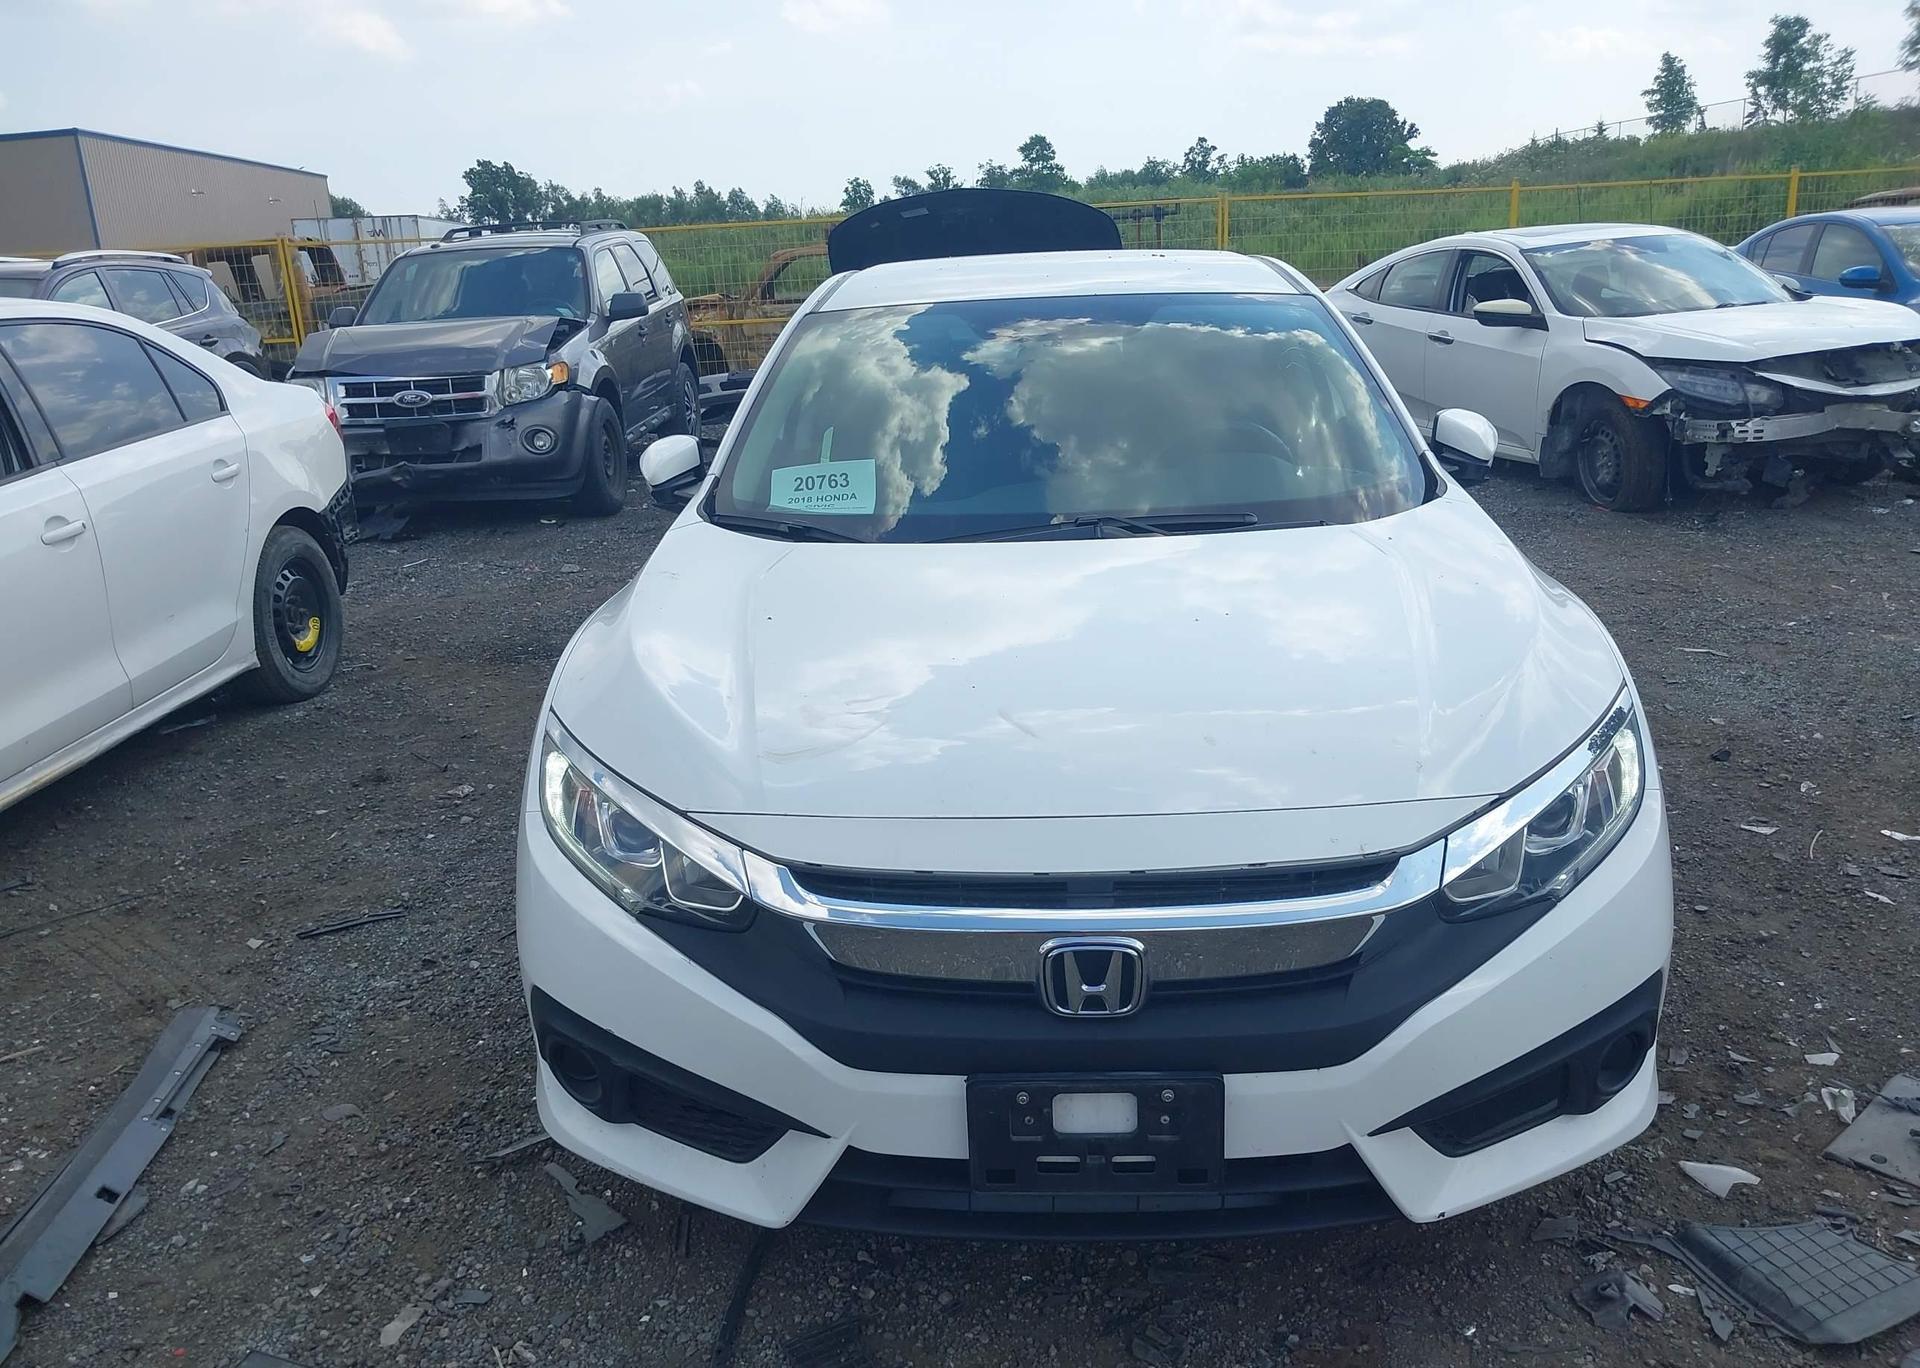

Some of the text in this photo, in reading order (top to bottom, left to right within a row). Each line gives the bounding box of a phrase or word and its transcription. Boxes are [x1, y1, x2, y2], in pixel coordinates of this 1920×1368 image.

[793, 472, 850, 492] 20763
[787, 492, 857, 504] 2018 HONDA
